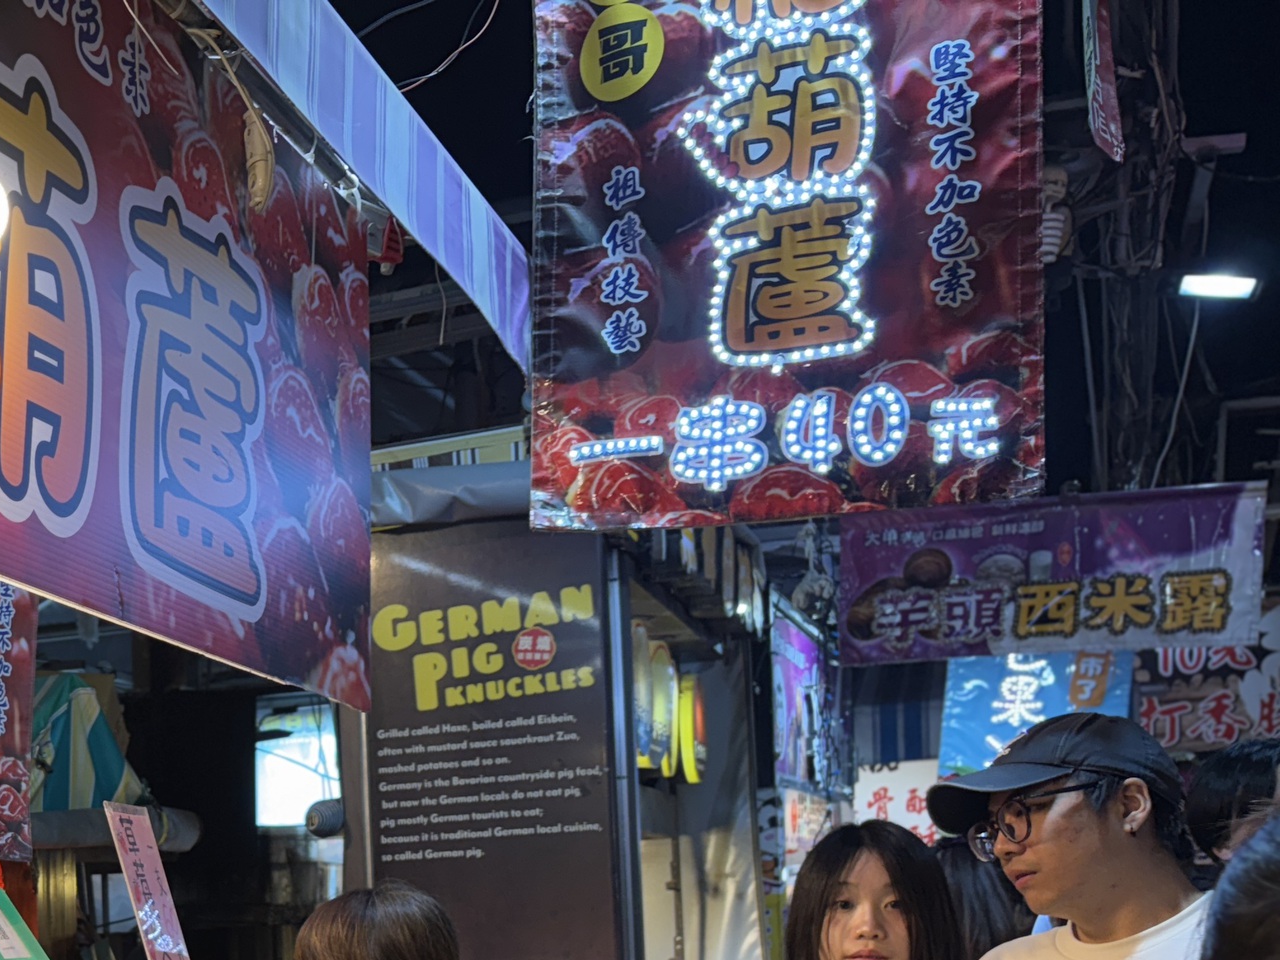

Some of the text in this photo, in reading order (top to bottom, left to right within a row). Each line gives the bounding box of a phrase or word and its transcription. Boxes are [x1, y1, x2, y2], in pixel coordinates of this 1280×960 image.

[598, 19, 648, 84] 哥
[721, 0, 864, 355] 葫蘆
[927, 39, 981, 309] 堅持不加色素
[602, 165, 650, 356] 祖傳技藝
[569, 381, 1001, 492] 一串40元
[372, 584, 595, 652] GERMAN
[875, 570, 1231, 649] 芋頭西米露
[412, 642, 504, 712] PIG
[443, 666, 595, 708] KNUCKLES
[1075, 650, 1107, 701] 市了
[377, 728, 409, 739] Grilled
[411, 725, 440, 736] called
[472, 719, 503, 730] boiled
[505, 716, 535, 728] called
[377, 747, 403, 757] often
[405, 744, 425, 754] with
[427, 740, 468, 753] mustard
[469, 739, 498, 749] sauce
[500, 733, 555, 747] sauerkraut
[378, 763, 415, 774] mashed
[417, 760, 459, 773] potatoes
[461, 757, 480, 768] and
[482, 758, 493, 766] so
[379, 782, 422, 793] Germany
[424, 779, 432, 788] is
[434, 777, 450, 787] the
[452, 776, 495, 786] Bavarian
[497, 770, 556, 783] countryside
[558, 768, 574, 779] pig
[380, 817, 395, 828] pig
[397, 815, 428, 826] mostly
[430, 813, 470, 823] German
[472, 810, 509, 820] tourists
[511, 809, 522, 818] to
[382, 800, 398, 809] but
[400, 800, 419, 808] now
[421, 797, 437, 806] the
[439, 795, 479, 805] German
[480, 791, 509, 802] locals
[511, 789, 524, 800] do
[527, 789, 543, 798] not
[545, 788, 562, 797] eat
[381, 835, 420, 844] because
[421, 833, 428, 842] it
[430, 832, 439, 841] is
[440, 828, 492, 840] traditional
[494, 827, 535, 838] German
[536, 823, 562, 834] local
[382, 854, 392, 862] so
[394, 850, 423, 861] called
[425, 849, 464, 859] German
